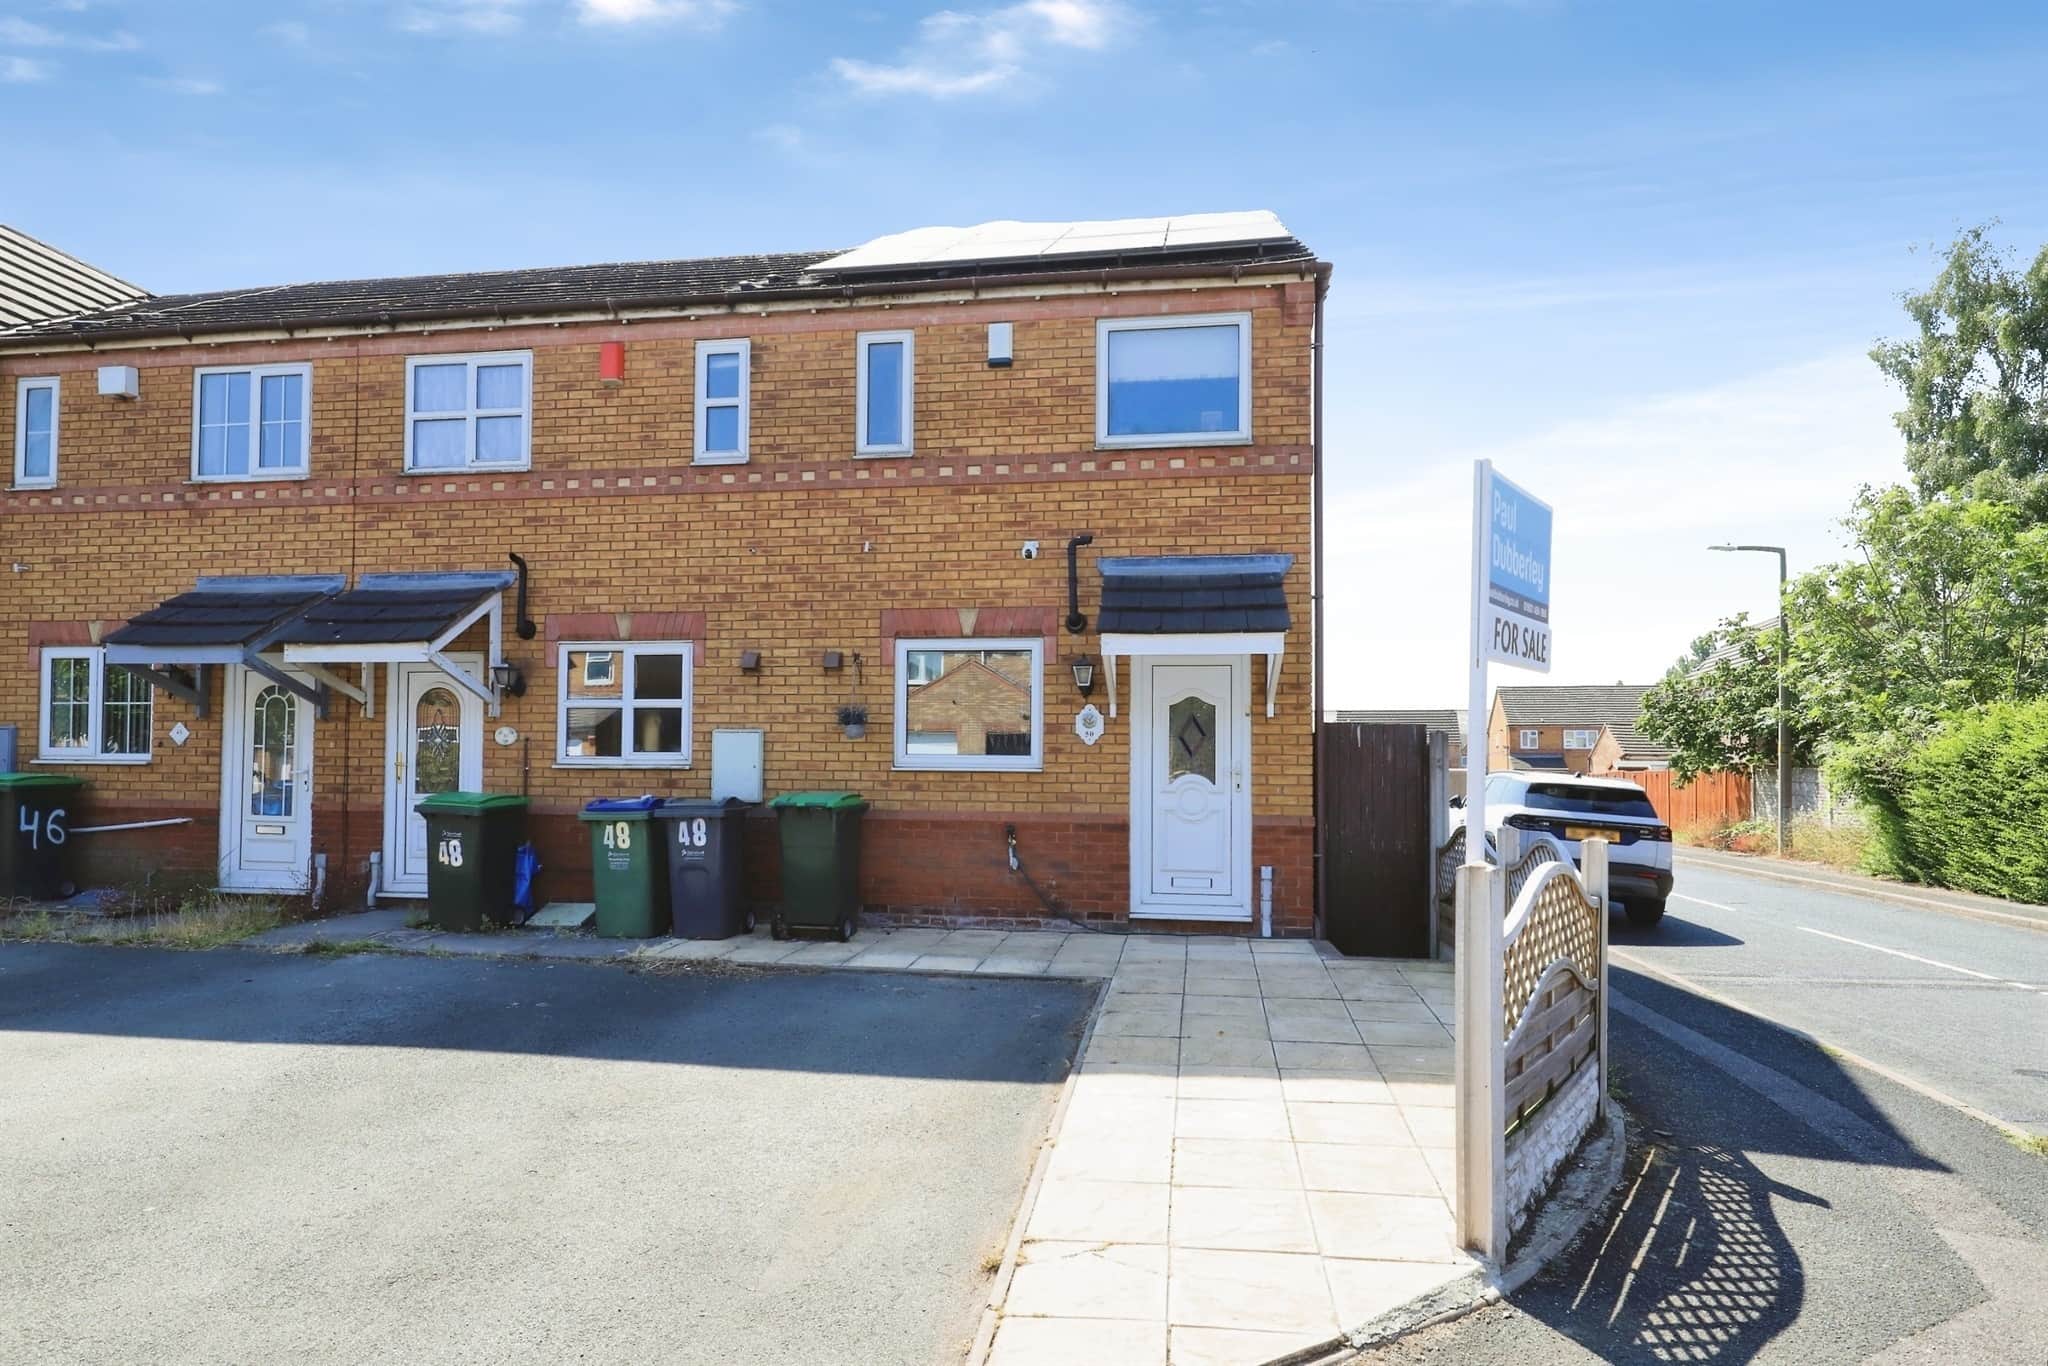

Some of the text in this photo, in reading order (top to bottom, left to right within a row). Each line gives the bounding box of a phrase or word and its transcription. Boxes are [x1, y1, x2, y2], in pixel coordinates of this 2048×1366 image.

[1493, 489, 1517, 533] Paul
[1492, 534, 1545, 592] Dubberley
[1493, 617, 1547, 663] FOR SALE
[19, 804, 66, 850] 46
[603, 821, 631, 849] 48
[678, 818, 707, 847] 48
[438, 839, 464, 867] 48
